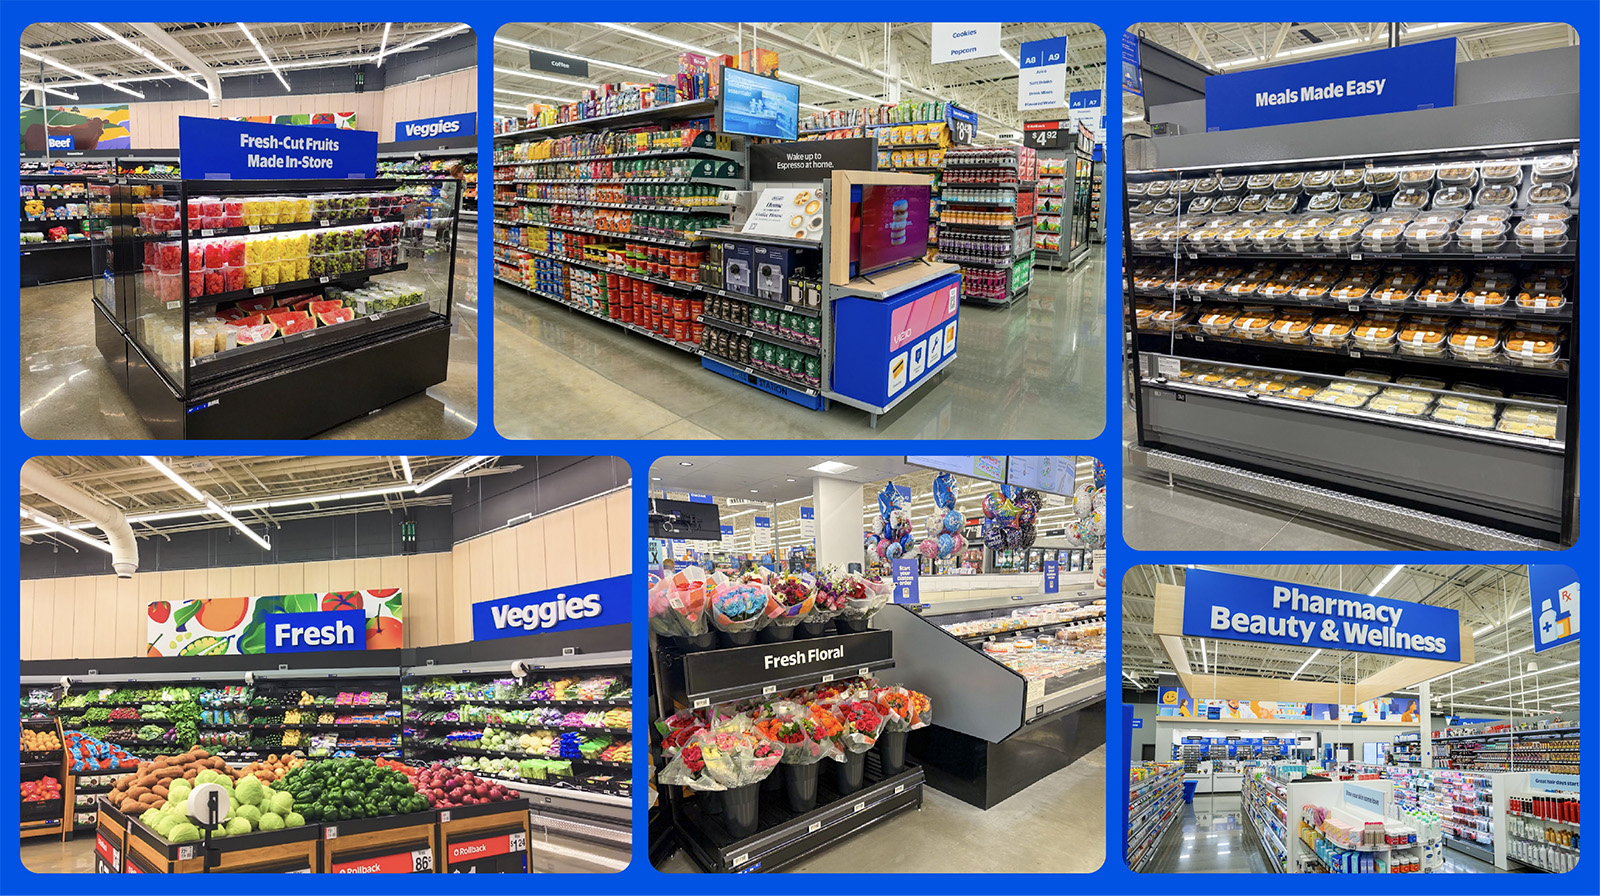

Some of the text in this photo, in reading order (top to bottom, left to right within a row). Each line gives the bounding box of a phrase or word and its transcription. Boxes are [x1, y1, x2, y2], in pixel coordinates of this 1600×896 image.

[952, 29, 976, 38] Cookies
[950, 46, 976, 56] Popcorn
[1048, 54, 1060, 62] A9
[551, 60, 570, 68] Coffee
[1256, 78, 1386, 107] Meals Made Easy
[406, 120, 460, 137] Veggies
[49, 138, 71, 148] Beef
[240, 134, 339, 151] Fresh-Cut Fruits
[248, 154, 333, 168] Made In-Store
[777, 162, 805, 170] Espresso
[760, 380, 788, 396] STATION
[491, 593, 602, 630] Veggies
[1273, 586, 1403, 627] Pharmacy
[275, 621, 355, 647] Fresh
[1211, 605, 1446, 654] Beauty & Wellness
[764, 644, 844, 670] Fresh Floral
[460, 844, 486, 856] Rollback
